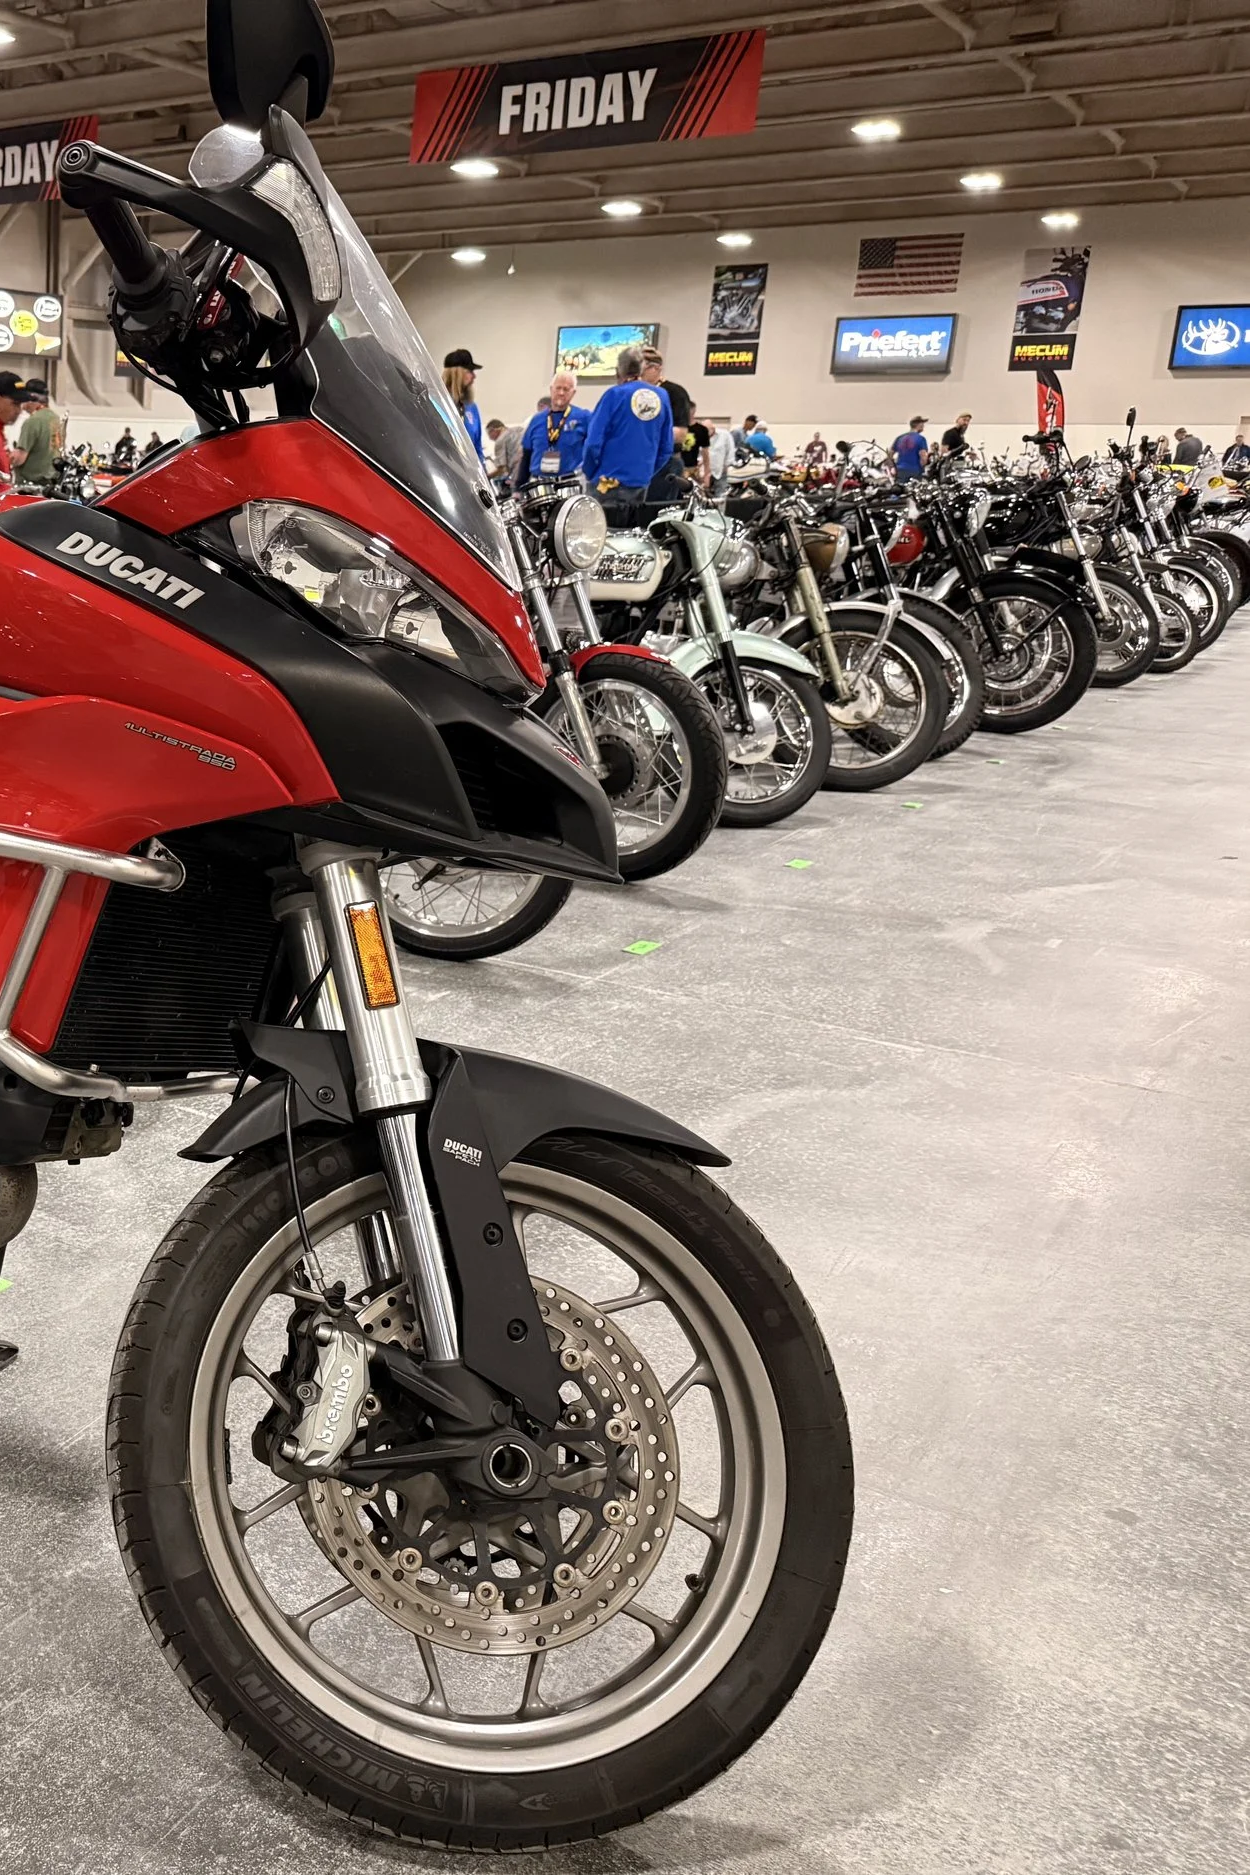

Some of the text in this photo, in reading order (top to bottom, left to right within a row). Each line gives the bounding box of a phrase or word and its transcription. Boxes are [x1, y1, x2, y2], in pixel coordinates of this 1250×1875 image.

[498, 68, 658, 136] FRIDAY
[708, 351, 754, 363] MECUM
[840, 329, 942, 354] Priefert
[1014, 344, 1069, 357] MECUM
[56, 531, 206, 610] DUCATI
[443, 1138, 482, 1159] DUCATI
[315, 1364, 353, 1445] brembo
[234, 1671, 401, 1793] MICHELIN
